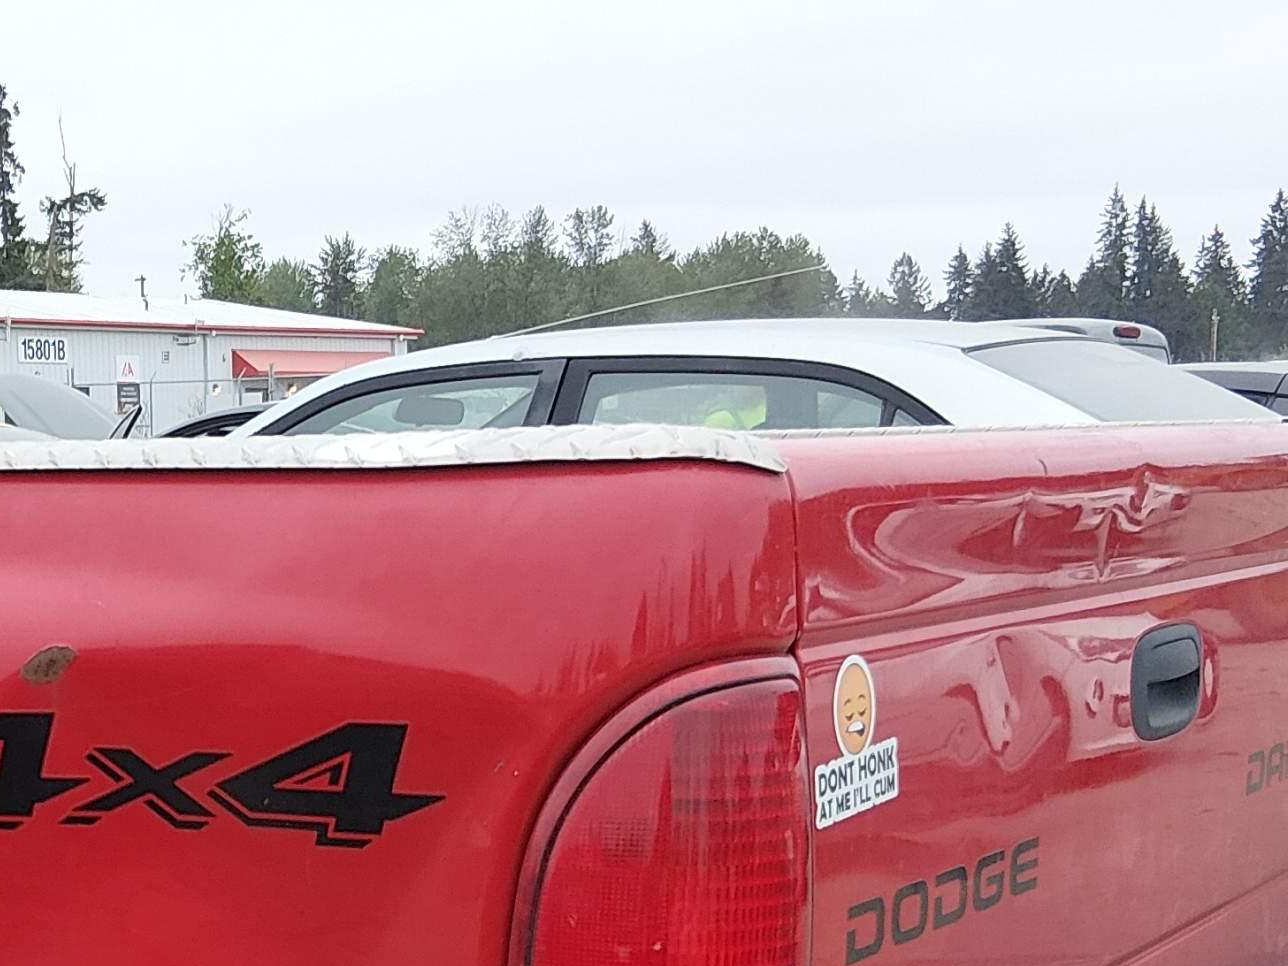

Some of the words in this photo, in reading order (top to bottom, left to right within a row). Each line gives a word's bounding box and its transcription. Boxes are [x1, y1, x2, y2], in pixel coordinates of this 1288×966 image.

[21, 337, 66, 361] 15801B
[818, 760, 855, 798] DONT
[858, 745, 895, 780] HONK
[819, 798, 834, 823] AT
[836, 793, 851, 814] ME
[853, 788, 871, 808] I'LL
[874, 774, 895, 798] CUM
[845, 836, 1040, 966] DODGE
